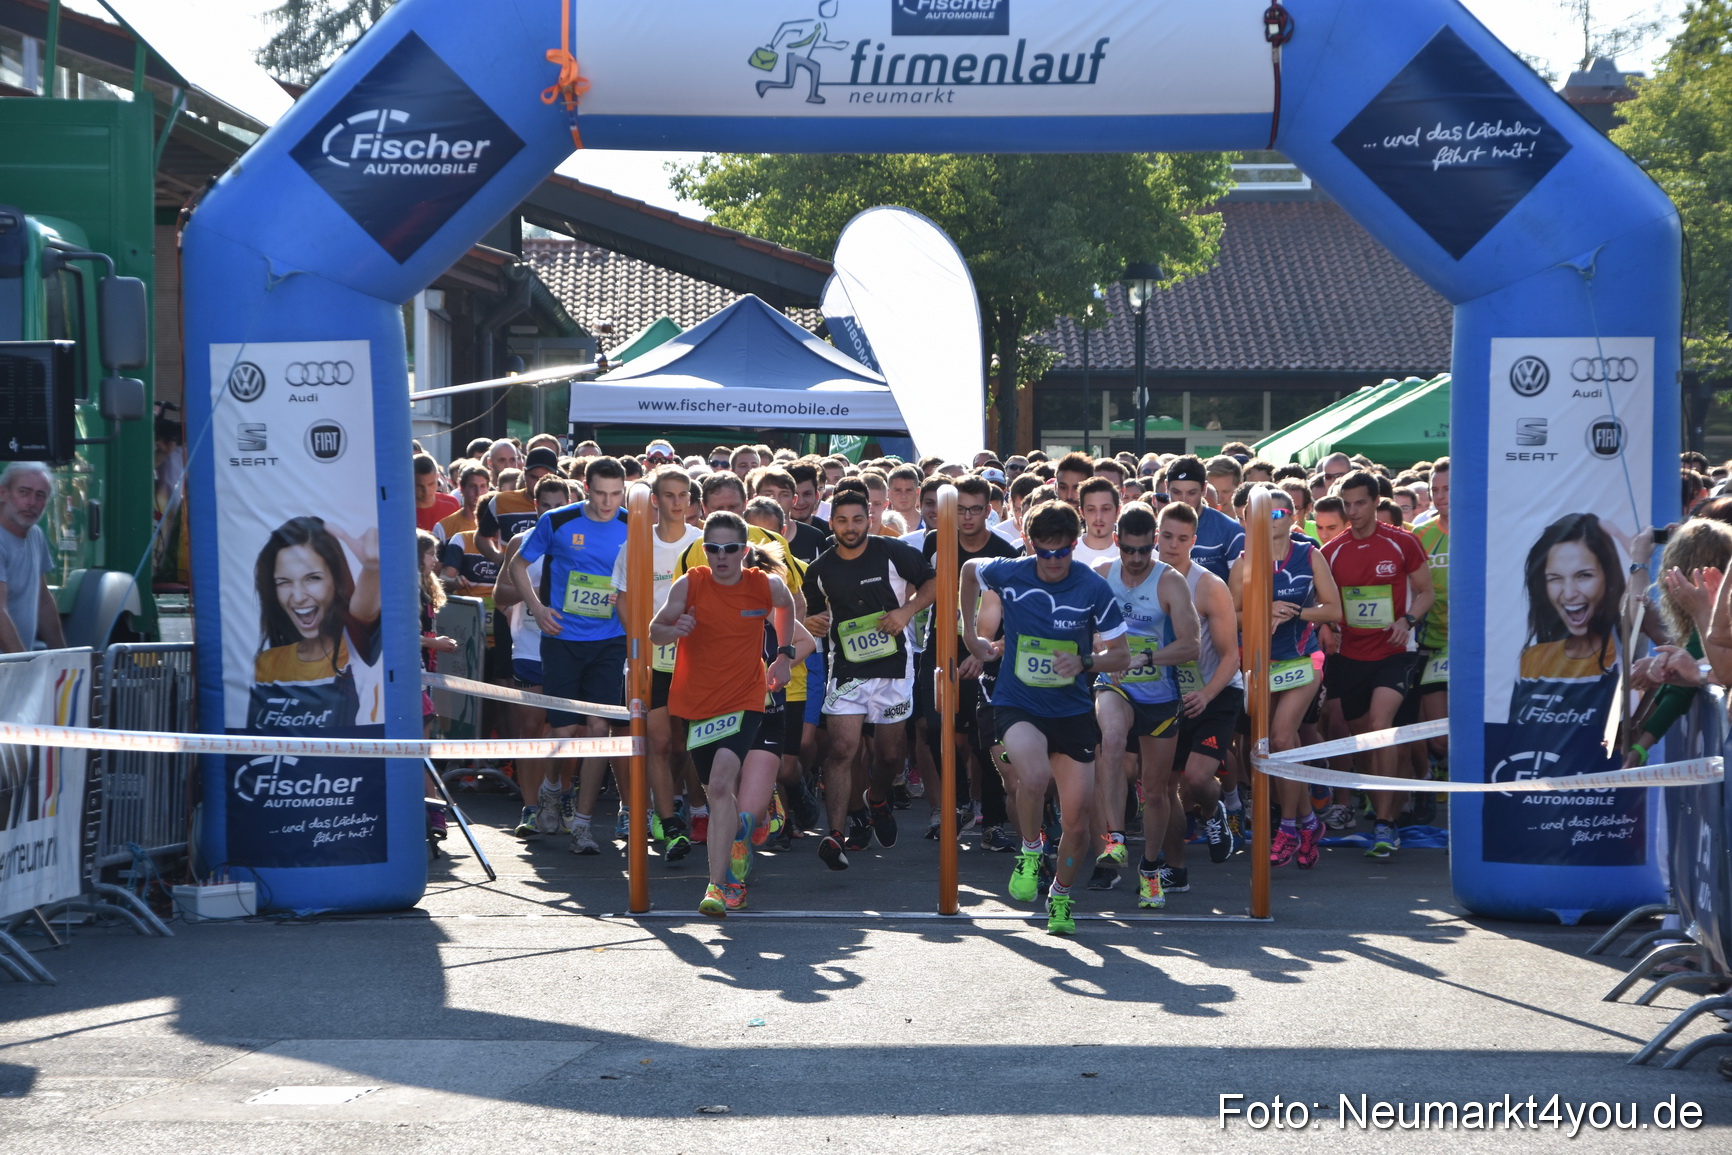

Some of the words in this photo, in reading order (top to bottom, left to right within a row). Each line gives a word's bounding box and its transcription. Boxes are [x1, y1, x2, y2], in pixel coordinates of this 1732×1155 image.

[917, 0, 1003, 10] Fischer
[925, 11, 995, 20] AUTOMOBILE
[850, 37, 1110, 84] firmenlauf
[849, 88, 955, 104] neumarkt
[1383, 127, 1421, 148] und
[1426, 122, 1463, 142] das
[351, 133, 490, 160] Fischer
[1432, 145, 1487, 172] fährt
[1492, 141, 1536, 159] mit!
[363, 162, 478, 175] AUTOMOBILE
[288, 393, 319, 403] Audi
[1572, 388, 1603, 399] Audi
[638, 399, 850, 416] www.fischer-automobile.de
[314, 431, 338, 452] FIAT
[1596, 428, 1619, 448] FIAT
[229, 457, 279, 467] SEAT
[1505, 452, 1559, 462] SEAT
[571, 589, 611, 607] 1284
[1358, 602, 1378, 618] 27
[847, 631, 890, 653] 1089
[1027, 656, 1057, 676] 95
[1273, 669, 1306, 686] 952
[263, 709, 333, 729] Fischer
[1526, 707, 1597, 726] Fischer
[694, 714, 738, 738] 1030
[253, 773, 363, 797] Fischer
[263, 796, 355, 809] AUTOMOBILE
[1522, 795, 1615, 807] AUTOMOBILE
[282, 820, 306, 834] und
[308, 816, 331, 830] das
[1540, 818, 1565, 833] und
[1567, 815, 1592, 829] das
[312, 831, 346, 848] fährt
[348, 825, 375, 839] mit!
[1571, 829, 1605, 847] fährt
[1608, 827, 1634, 840] mit!
